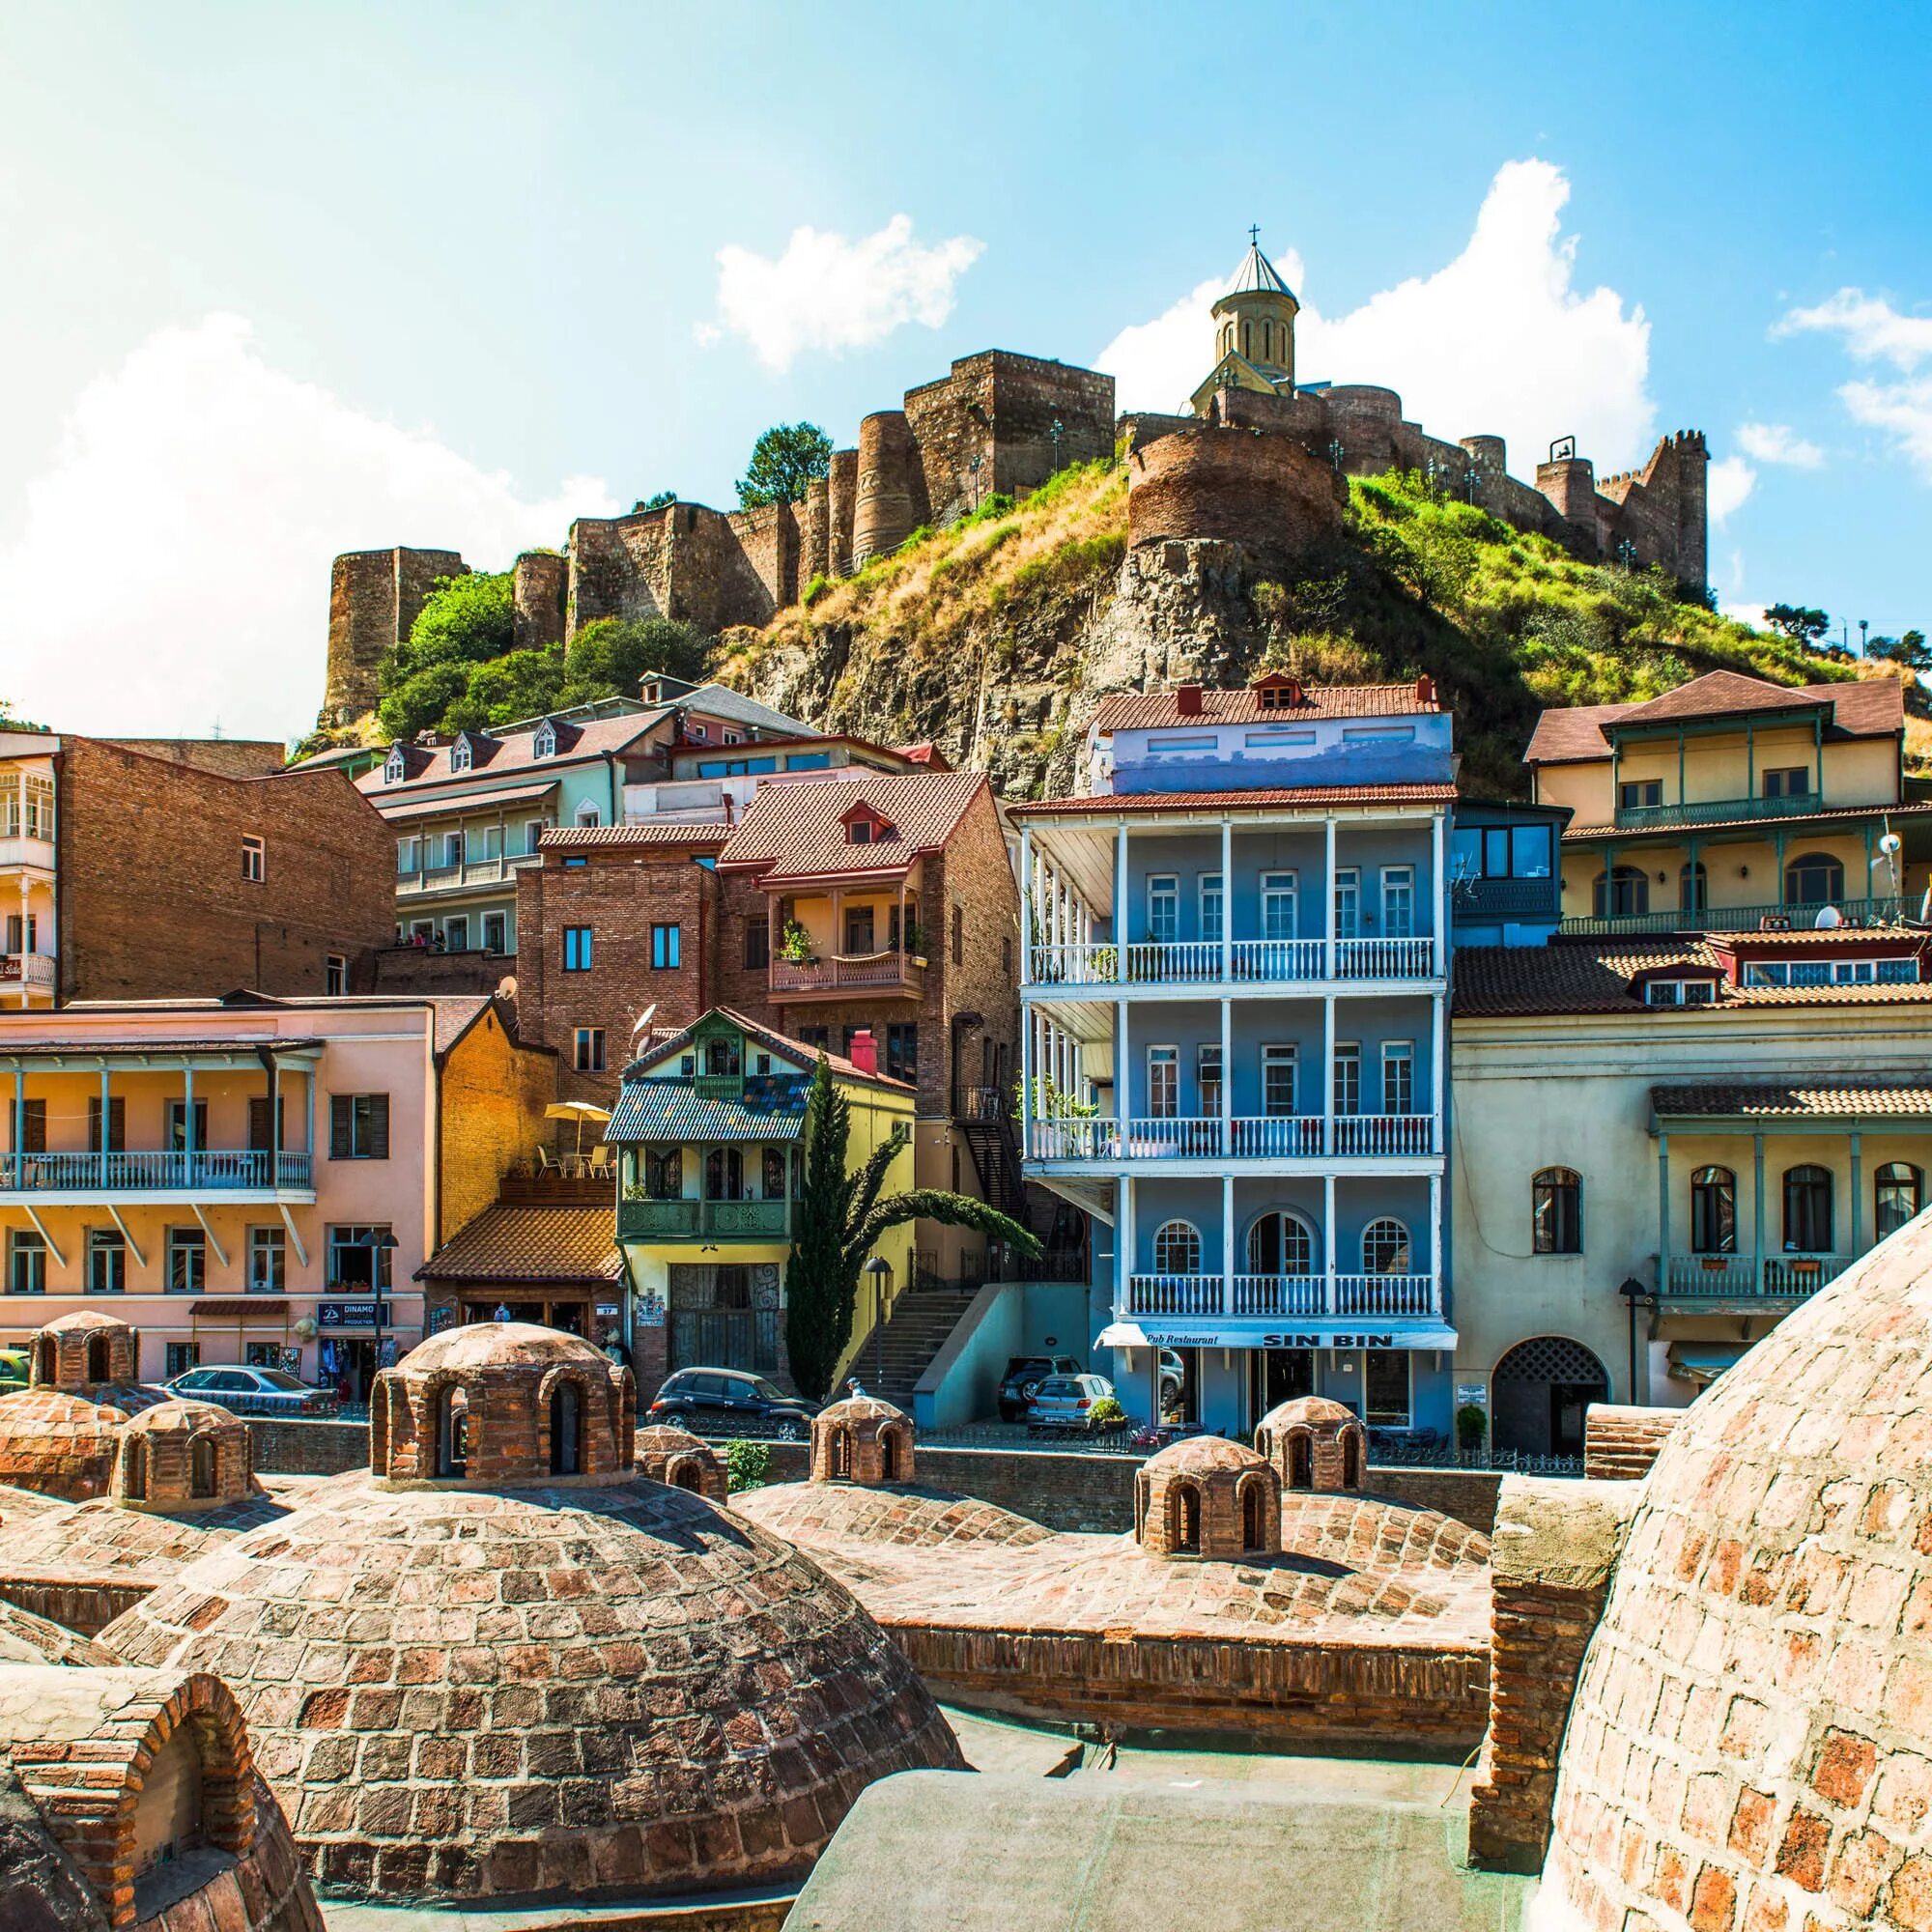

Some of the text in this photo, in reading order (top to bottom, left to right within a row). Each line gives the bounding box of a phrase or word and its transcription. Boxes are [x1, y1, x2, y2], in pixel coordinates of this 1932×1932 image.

[1147, 1334, 1218, 1345] Pub Restaurant
[1264, 1335, 1392, 1347] SIN BIN
